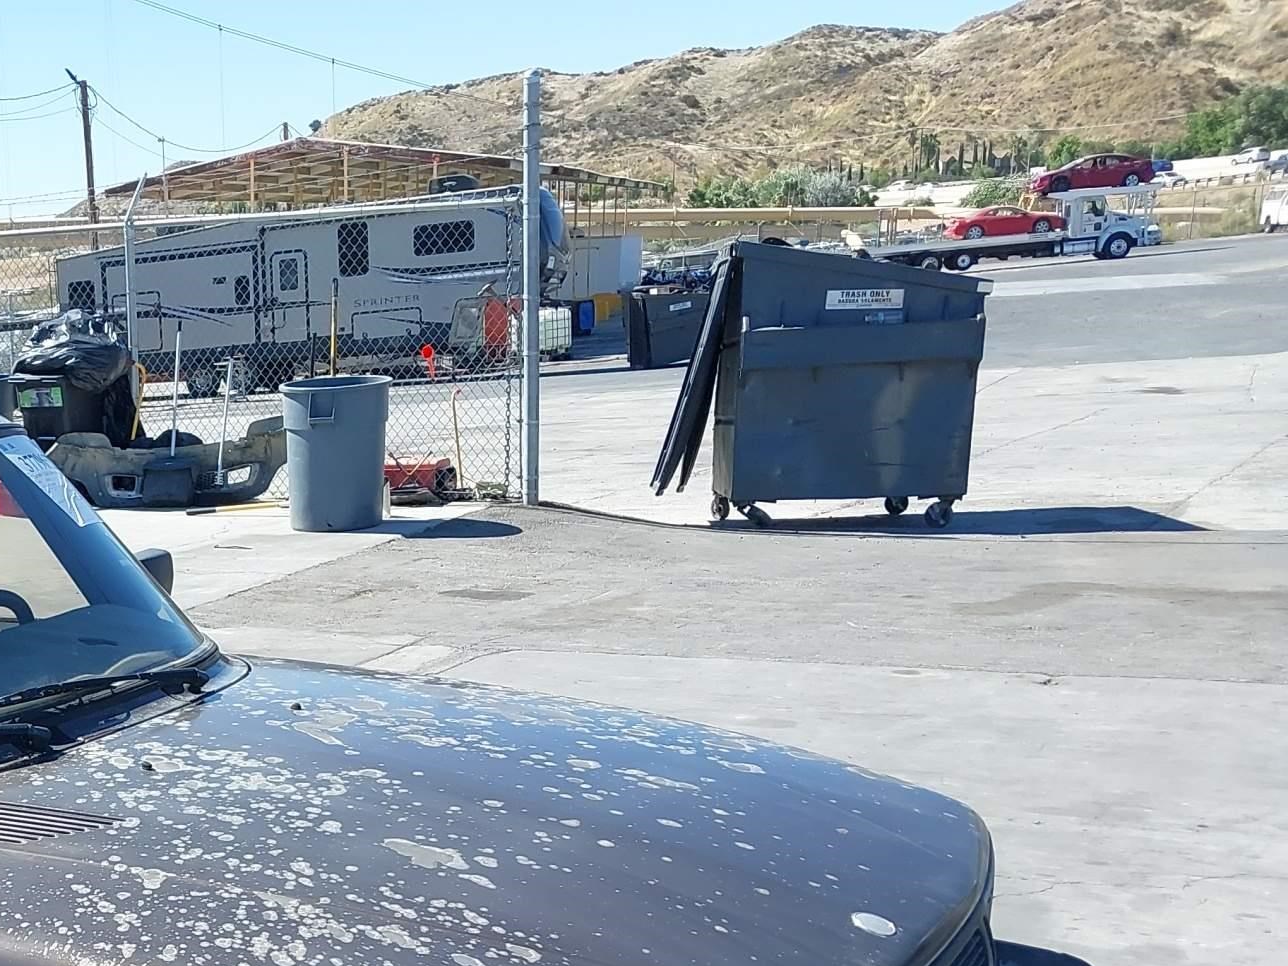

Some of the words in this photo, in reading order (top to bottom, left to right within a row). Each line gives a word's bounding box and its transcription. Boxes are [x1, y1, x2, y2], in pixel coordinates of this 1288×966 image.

[840, 290, 867, 298] TRASH
[869, 290, 891, 298] ONLY
[353, 294, 420, 308] SPRINTER
